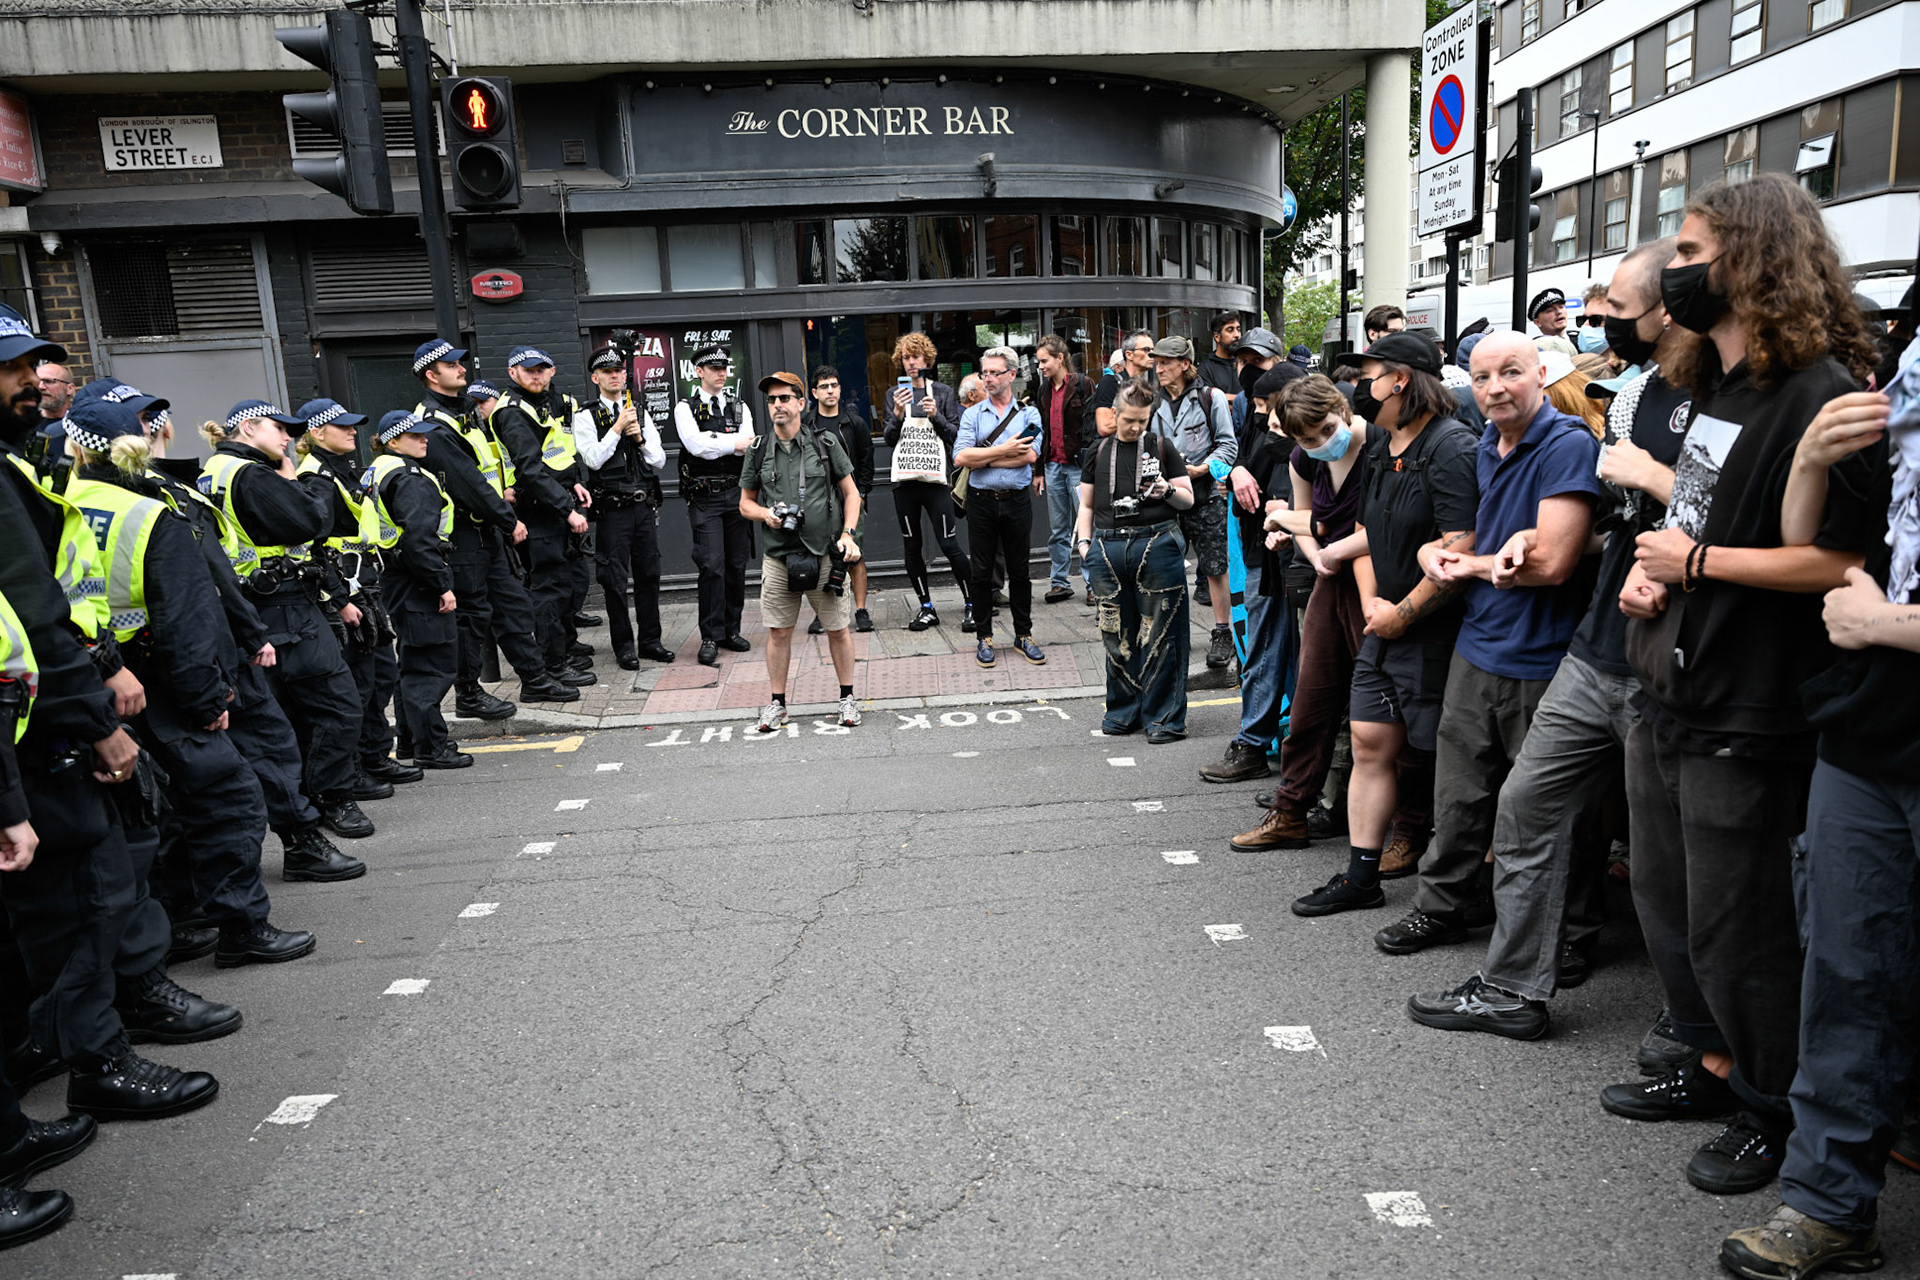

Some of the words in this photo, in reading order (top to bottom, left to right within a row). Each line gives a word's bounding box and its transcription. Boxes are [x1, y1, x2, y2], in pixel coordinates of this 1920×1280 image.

[1425, 9, 1474, 53] Controlled
[1431, 39, 1465, 76] ZONE
[728, 111, 772, 132] The
[777, 107, 933, 139] CORNER
[942, 106, 1015, 135] BAR
[111, 128, 174, 147] LEVER
[115, 148, 188, 167] STREET
[1429, 187, 1436, 198] At
[1436, 185, 1447, 195] any
[1448, 179, 1462, 191] time
[1434, 198, 1456, 212] Sunday
[1424, 213, 1448, 229] Midnight
[897, 456, 941, 465] MIGRANTS
[898, 463, 941, 471] WELCOME
[897, 706, 1071, 730] LOOK
